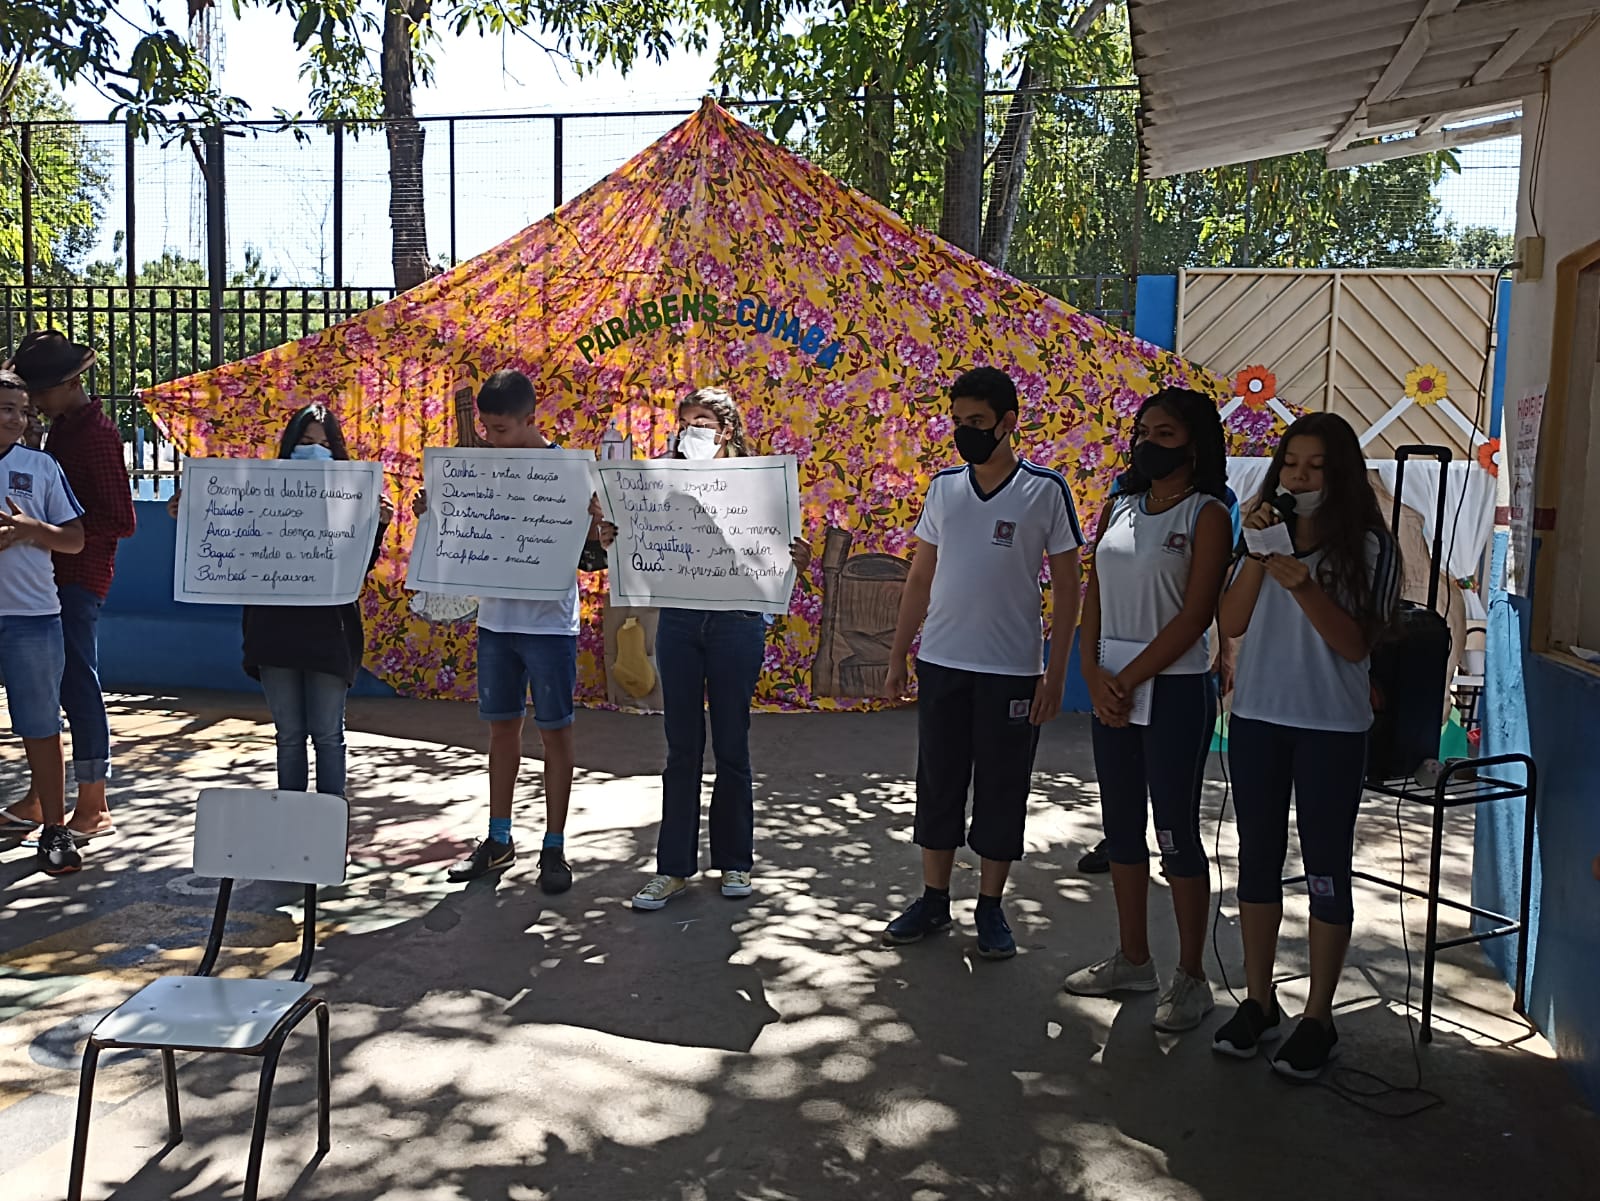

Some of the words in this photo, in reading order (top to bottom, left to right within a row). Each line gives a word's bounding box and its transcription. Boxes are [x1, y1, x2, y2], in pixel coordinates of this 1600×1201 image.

[575, 293, 719, 364] PARABENS
[736, 298, 841, 370] CUIABA
[207, 476, 261, 501] Exemplos
[265, 476, 275, 497] de
[281, 478, 317, 498] dialeto
[320, 486, 363, 500] cuiabano
[682, 478, 727, 498] esperto
[259, 507, 304, 519] curioso
[319, 525, 356, 546] regional
[692, 522, 722, 535] mais
[729, 523, 743, 534] ou
[746, 523, 782, 536] menos
[286, 550, 295, 560] a
[301, 545, 336, 560] valente
[708, 546, 735, 558] sem
[740, 540, 773, 556] valor
[677, 564, 726, 579] expressão
[729, 560, 740, 577] de
[744, 562, 785, 580] espanto
